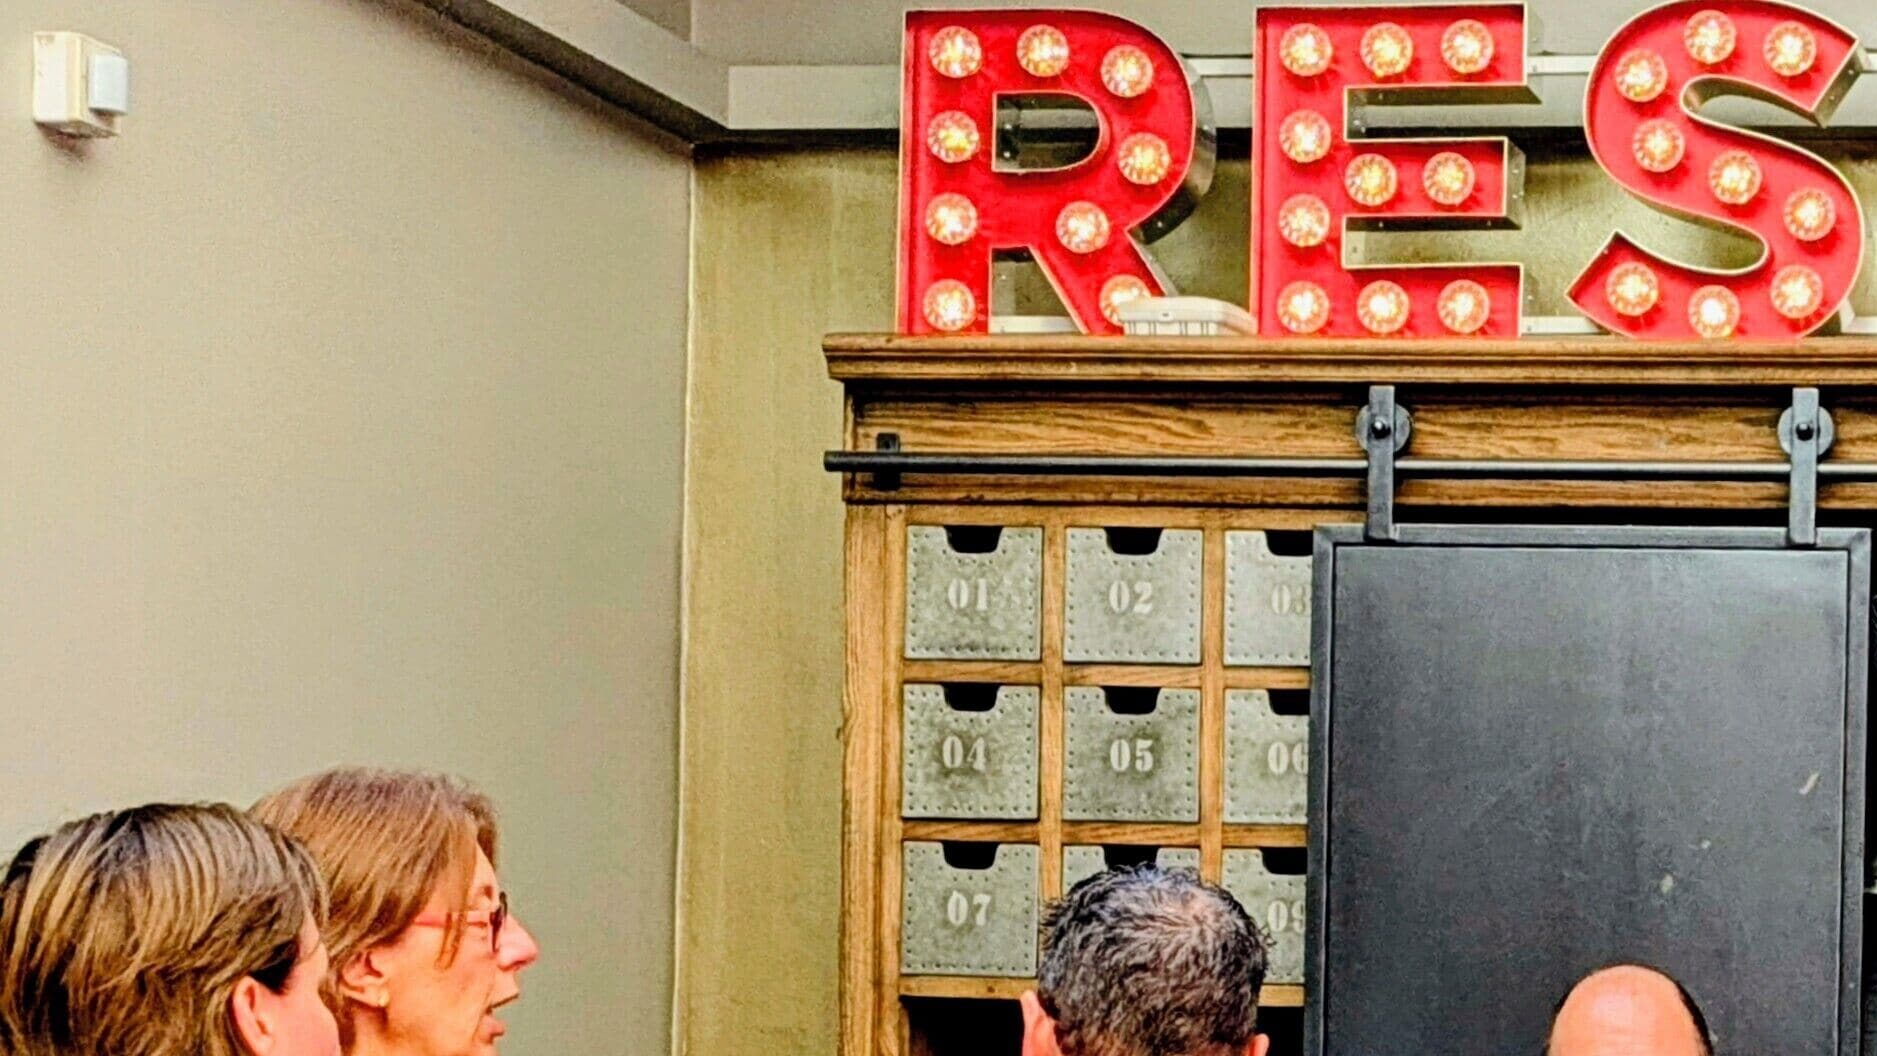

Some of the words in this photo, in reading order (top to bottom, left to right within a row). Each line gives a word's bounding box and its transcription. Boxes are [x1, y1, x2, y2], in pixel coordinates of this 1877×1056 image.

[948, 578, 988, 611] 01
[1109, 580, 1153, 615] 02
[942, 735, 986, 772] 04
[1110, 739, 1153, 773] 05
[946, 890, 993, 927] 07
